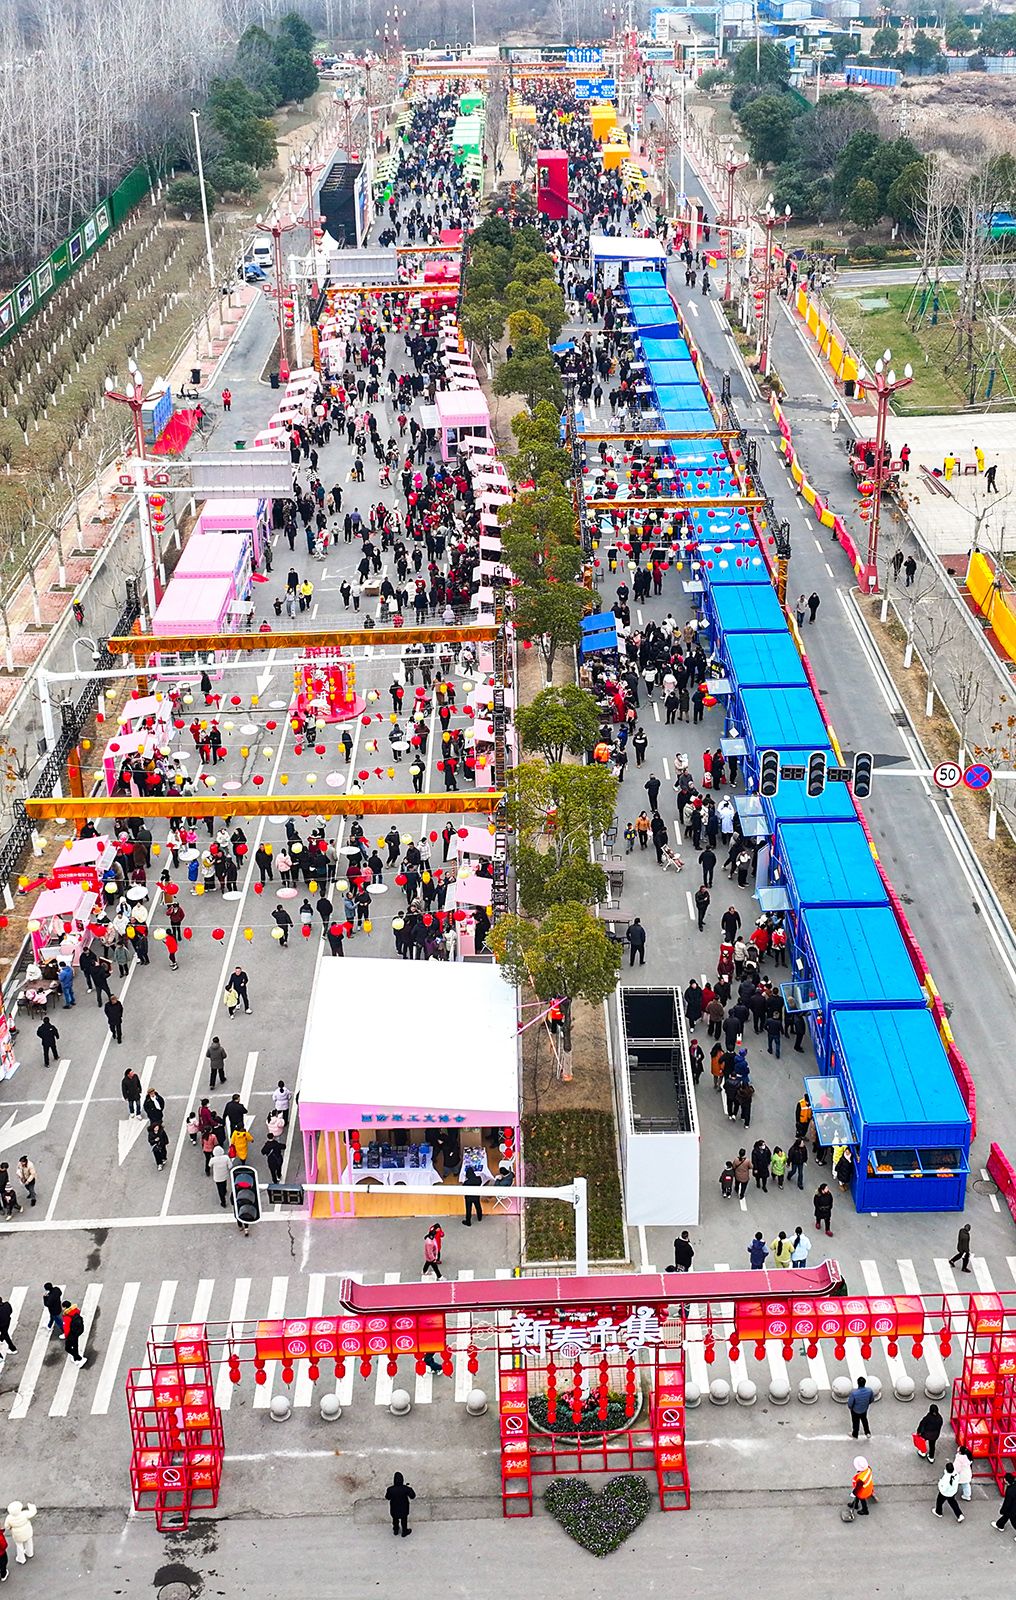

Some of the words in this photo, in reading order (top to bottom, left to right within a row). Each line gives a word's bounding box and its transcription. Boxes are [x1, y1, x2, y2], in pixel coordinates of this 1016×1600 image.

[939, 768, 956, 781] 50
[510, 1305, 663, 1359] 新春市集
[770, 1319, 892, 1335] 赏经典非遗
[290, 1336, 412, 1354] 品年味美食
[1000, 1359, 1016, 1371] 福
[156, 1392, 173, 1404] 福
